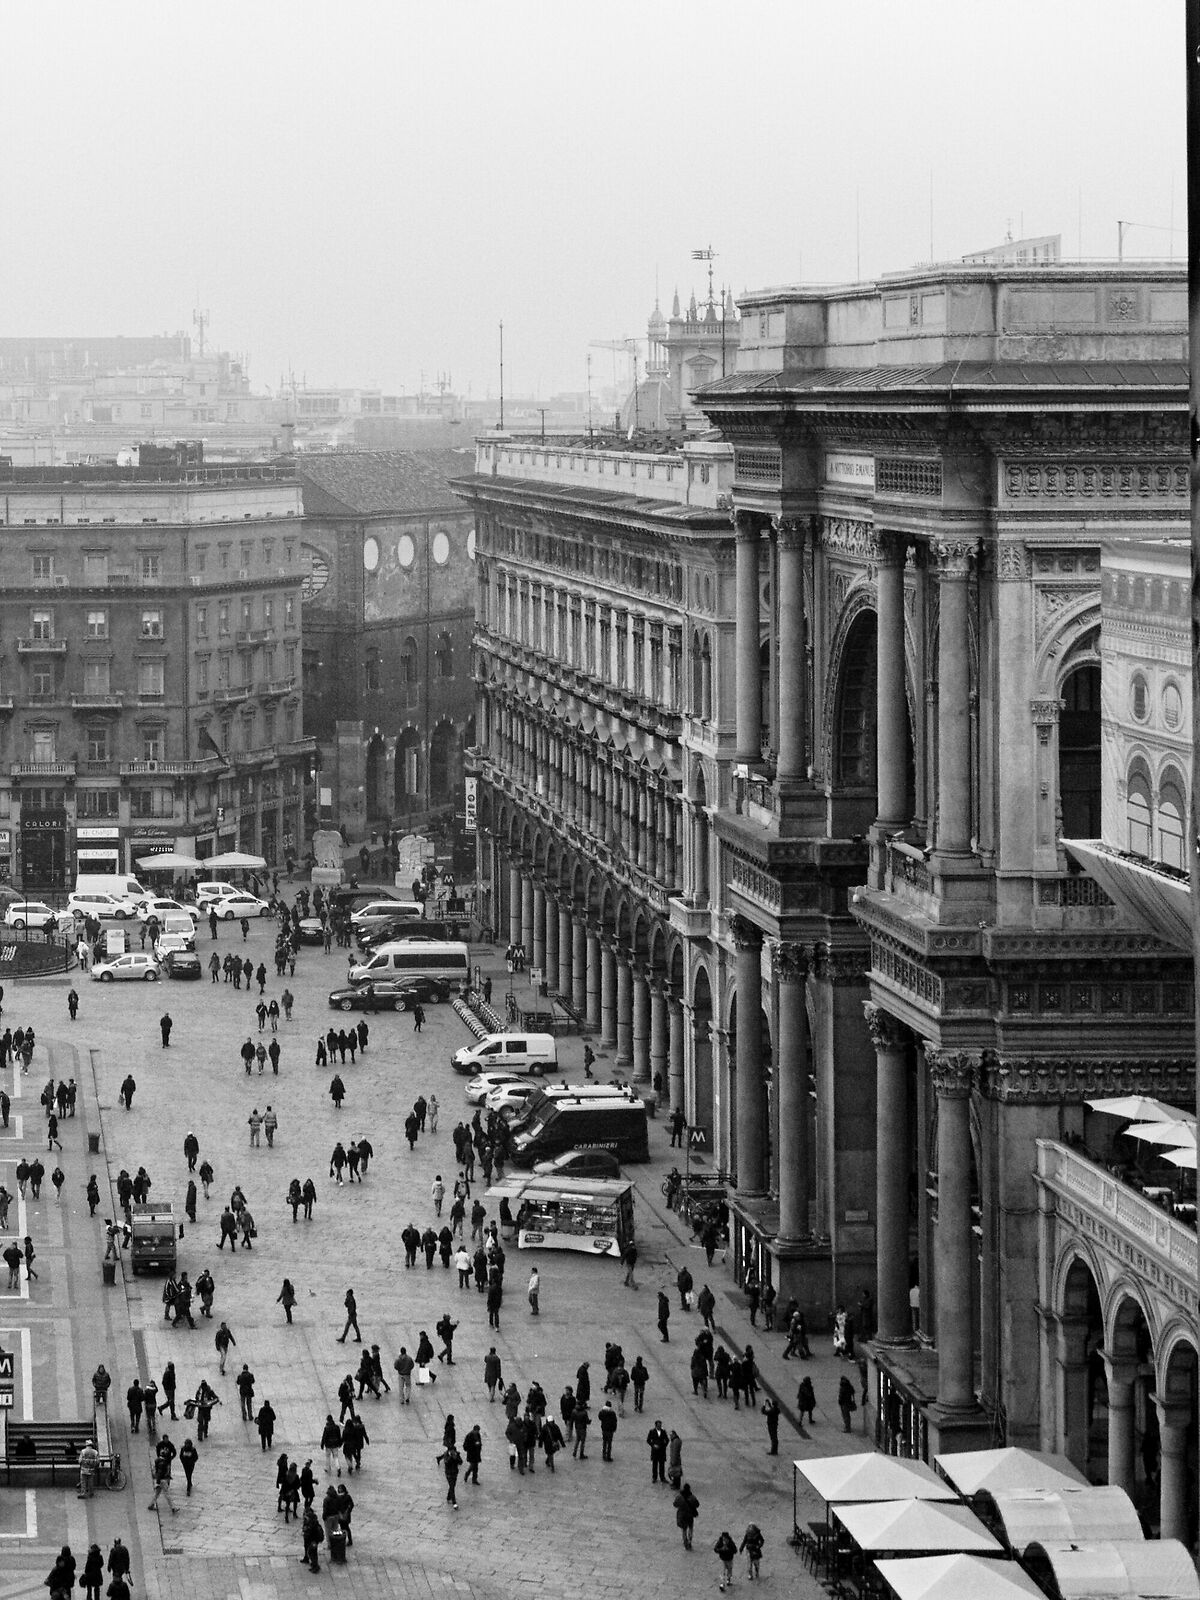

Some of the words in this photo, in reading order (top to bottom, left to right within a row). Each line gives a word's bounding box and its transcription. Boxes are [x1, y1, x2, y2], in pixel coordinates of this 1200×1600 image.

[444, 875, 454, 883] M
[513, 949, 525, 958] M
[691, 1131, 705, 1142] M
[573, 1142, 618, 1150] CARABINIERI
